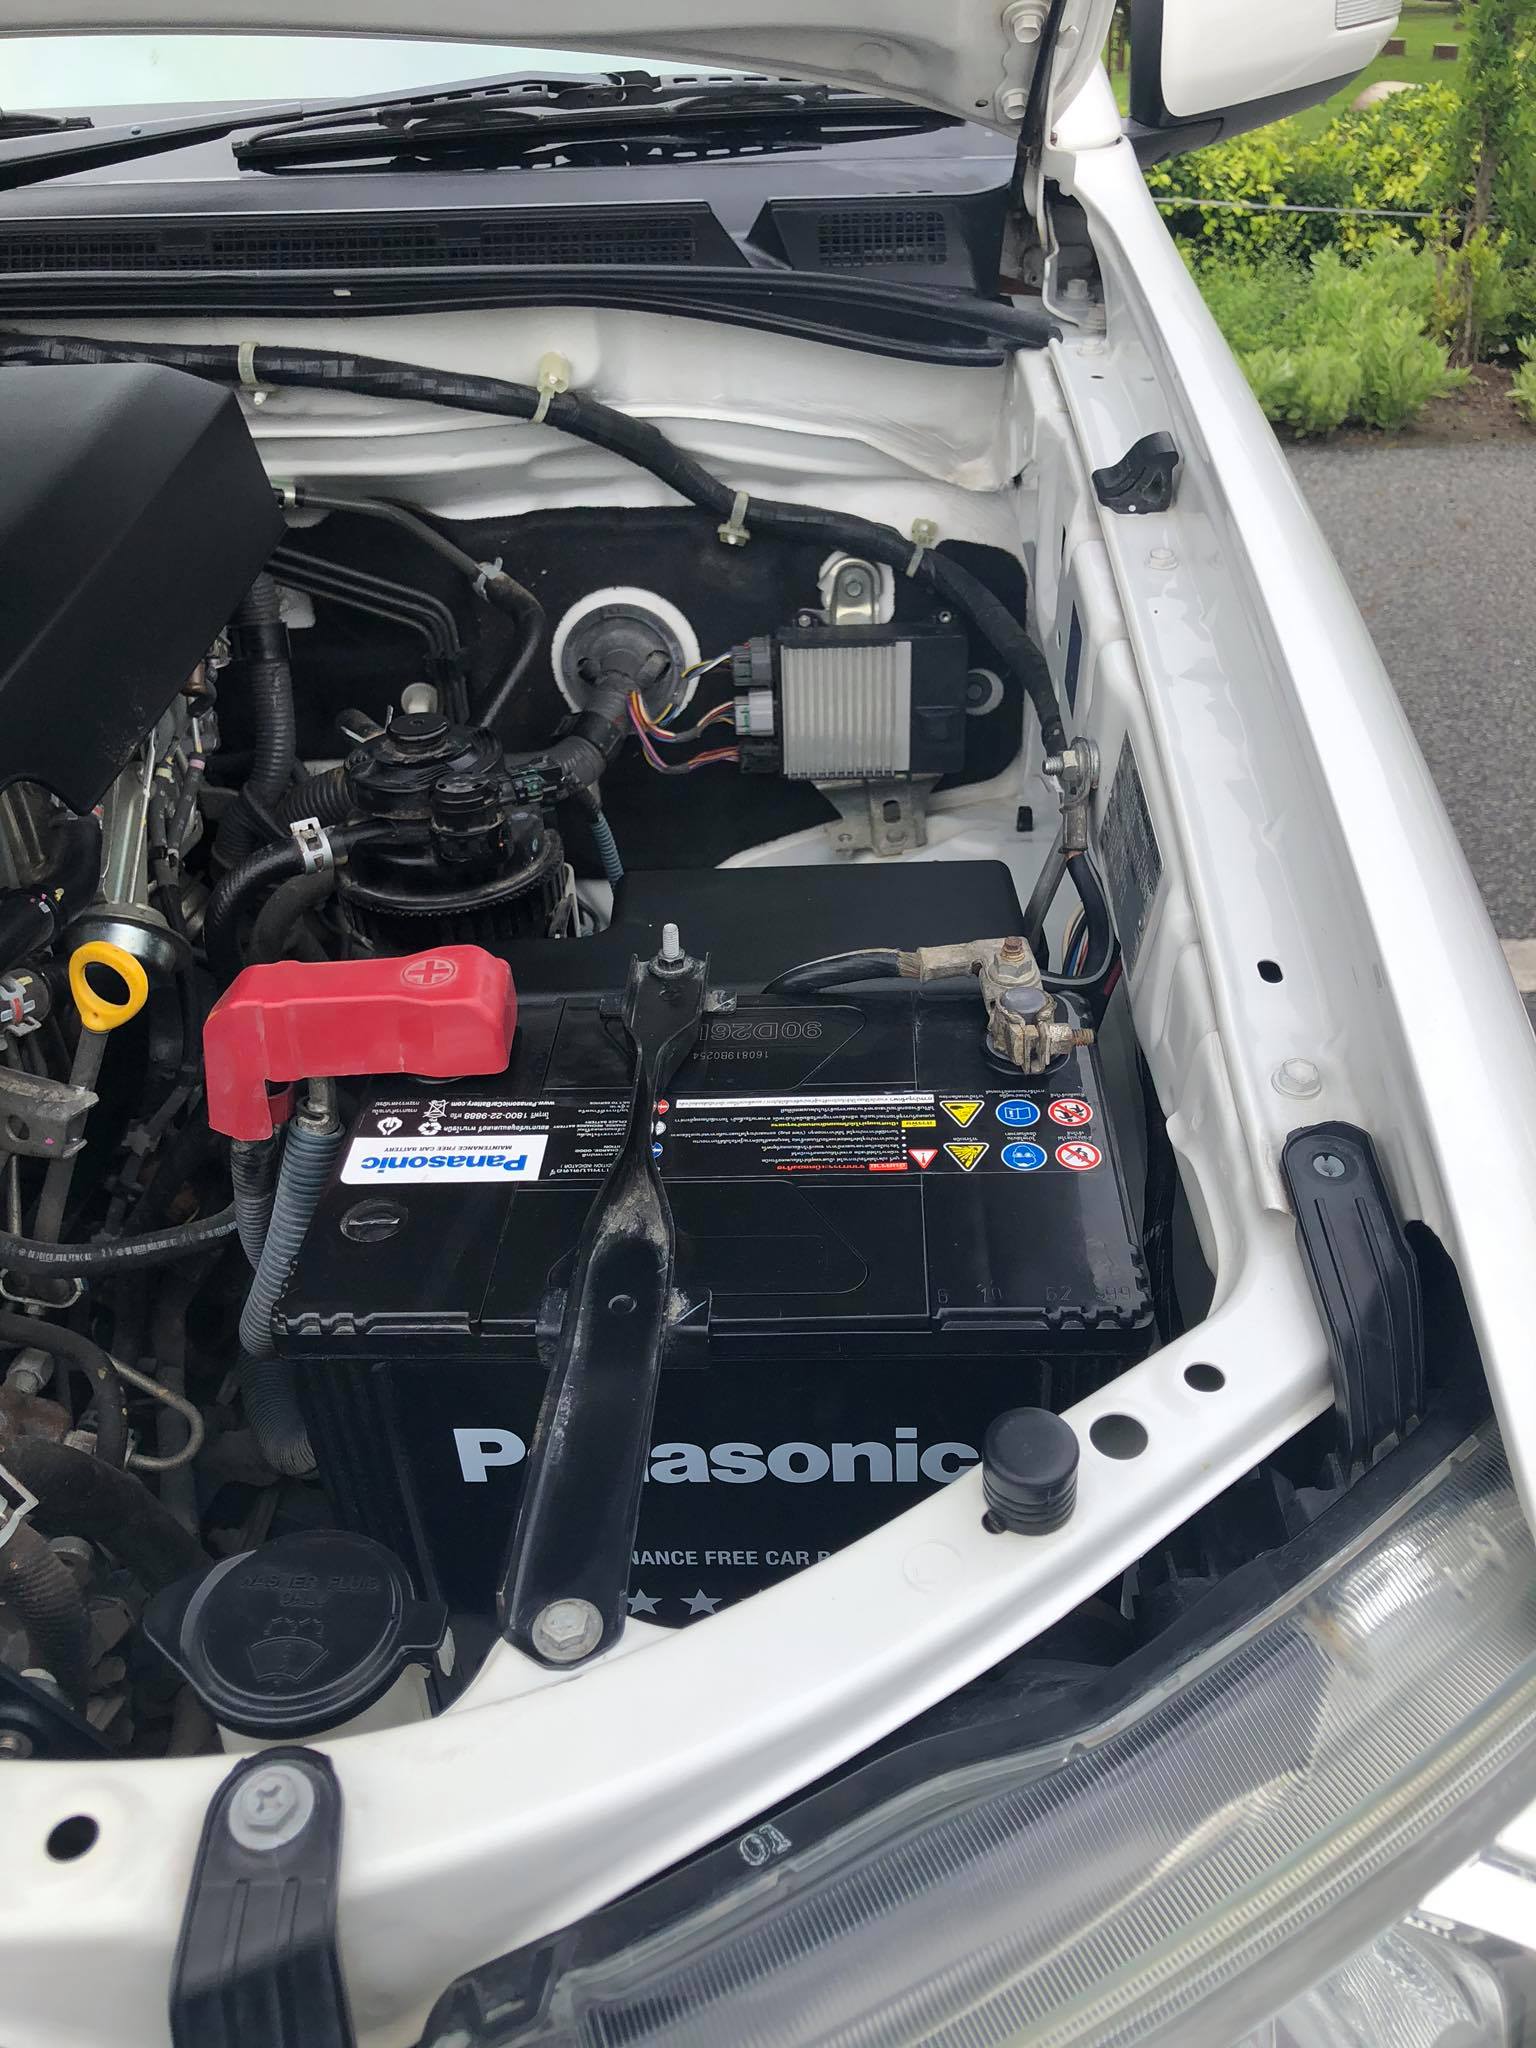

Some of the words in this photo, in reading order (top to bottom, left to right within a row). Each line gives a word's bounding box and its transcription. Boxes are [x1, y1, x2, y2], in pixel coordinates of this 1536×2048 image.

[450, 1099, 555, 1108] www.PanasonicCarBattery.com
[464, 1112, 528, 1120] 1800-22-9888
[361, 1155, 529, 1174] Panasonic
[452, 1427, 982, 1484] Pasonic
[704, 1550, 759, 1566] FREE
[765, 1550, 810, 1566] CAR
